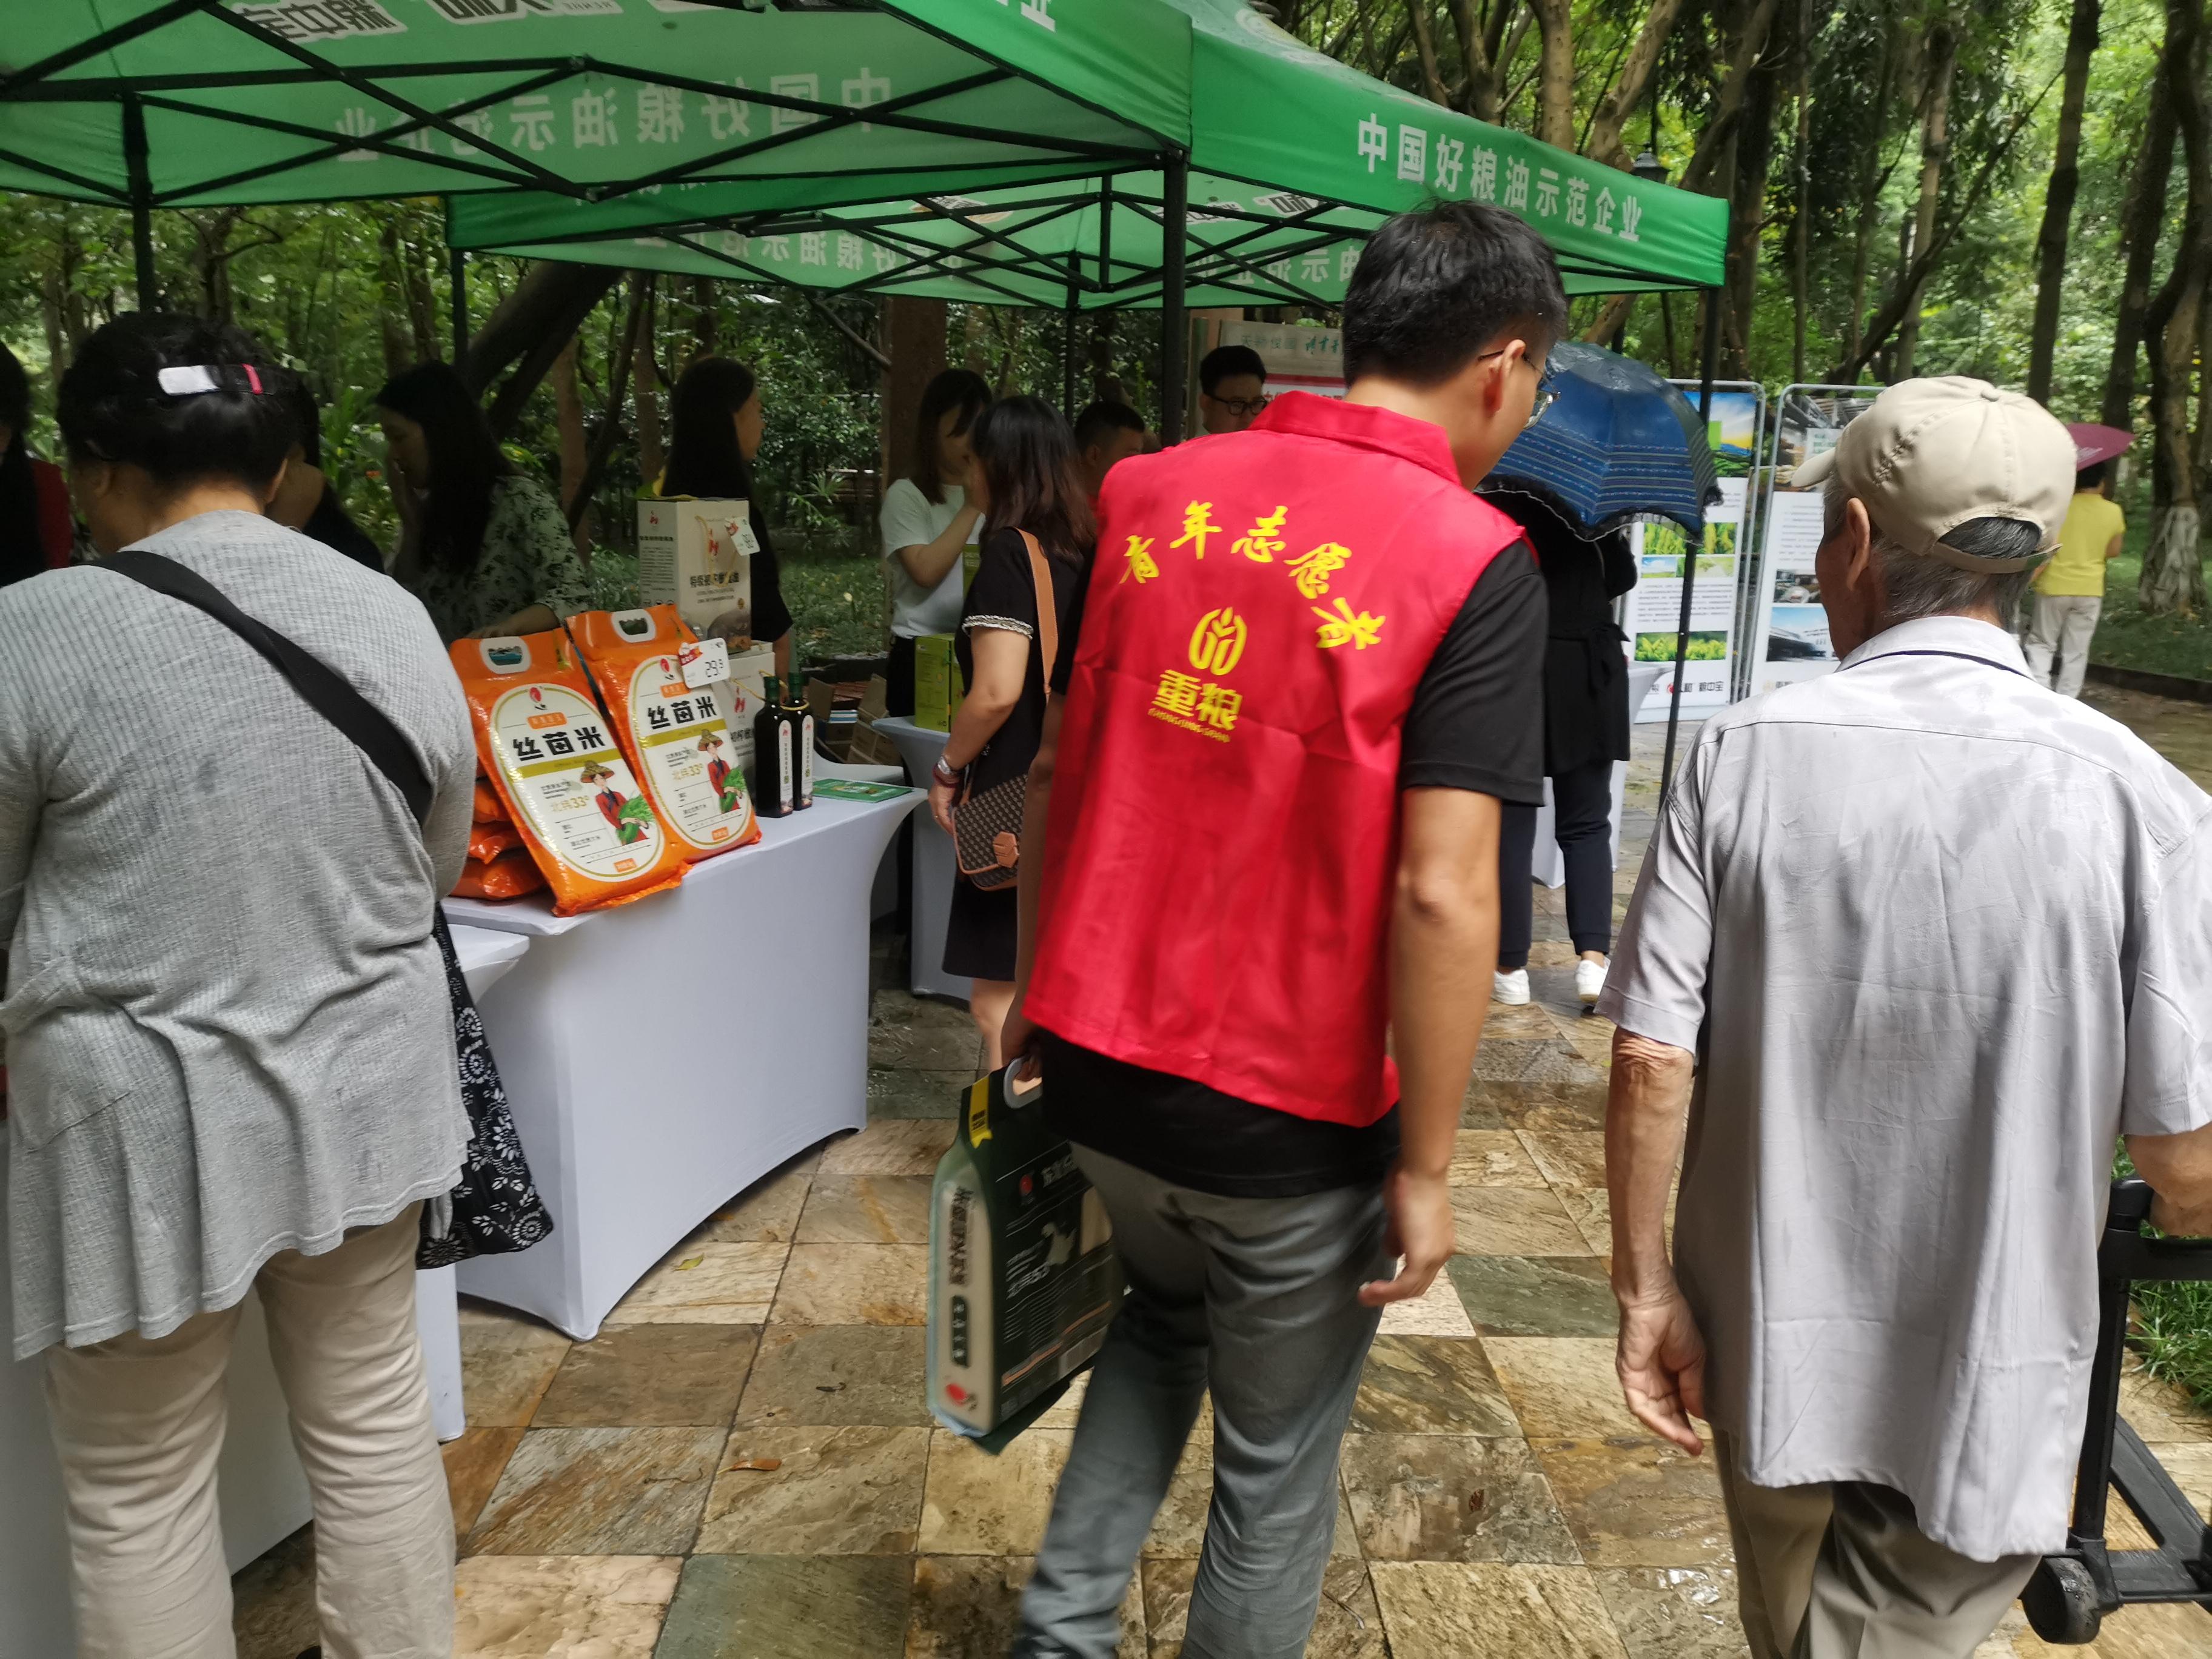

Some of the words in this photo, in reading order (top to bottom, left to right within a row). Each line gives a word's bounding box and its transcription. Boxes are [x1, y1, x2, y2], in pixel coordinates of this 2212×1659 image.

[1358, 113, 1643, 241] 中国好粮油示范企业
[1119, 500, 1386, 650] 青年志愿者
[1151, 669, 1242, 731] 重粮
